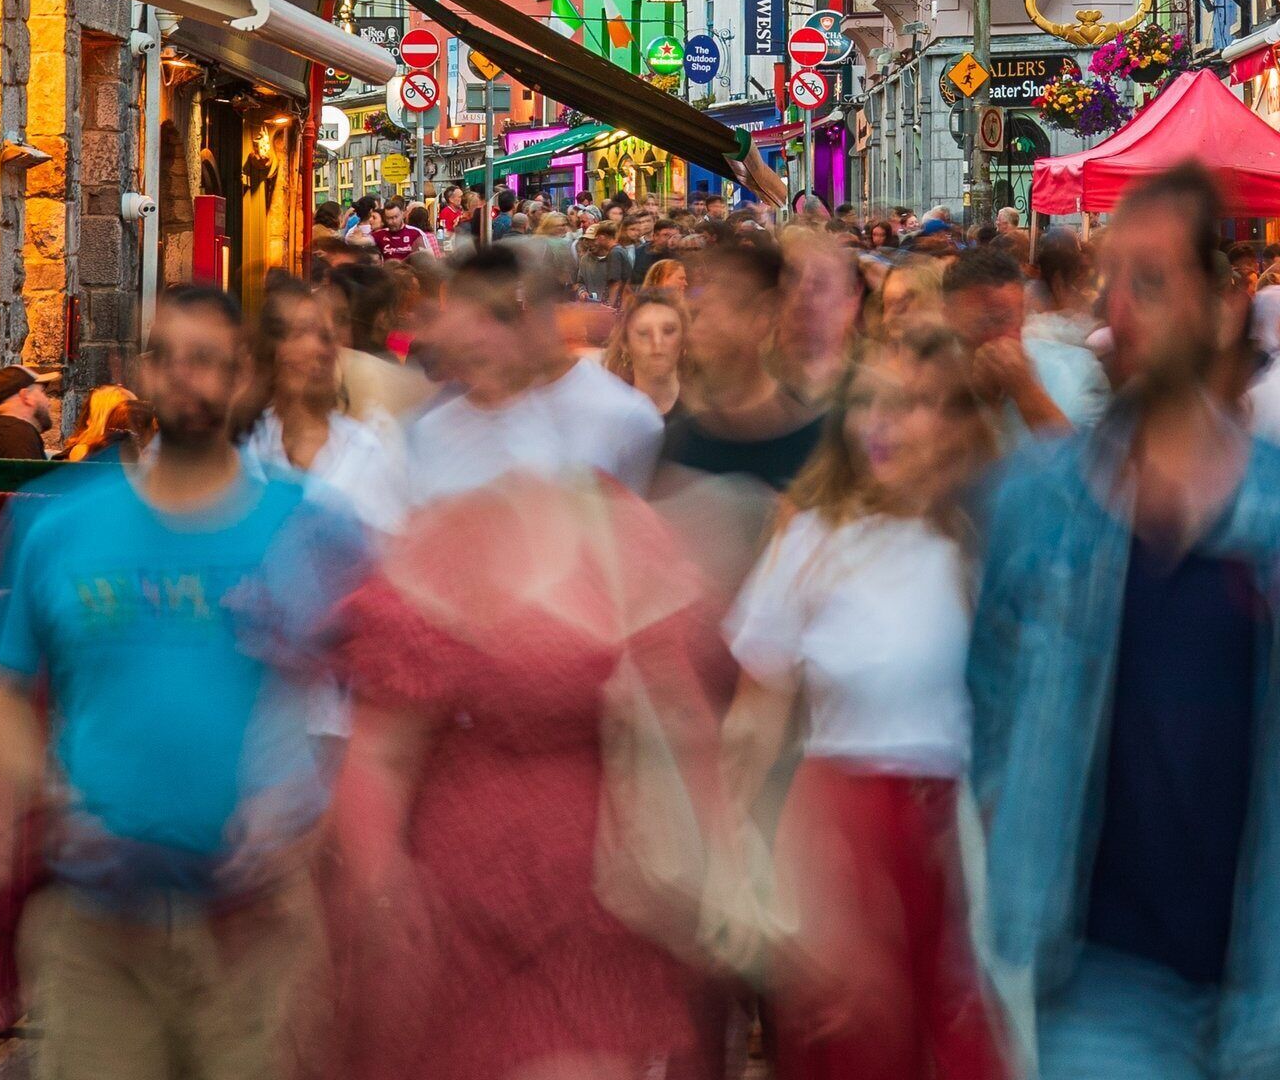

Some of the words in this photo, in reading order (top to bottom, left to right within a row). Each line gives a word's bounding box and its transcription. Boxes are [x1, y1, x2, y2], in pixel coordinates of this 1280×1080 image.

[694, 46, 710, 55] The
[686, 54, 717, 63] Outdoor
[691, 63, 711, 73] Shop
[989, 60, 1046, 78] ALLER'S
[989, 83, 1022, 99] eater
[1022, 80, 1046, 98] Sho
